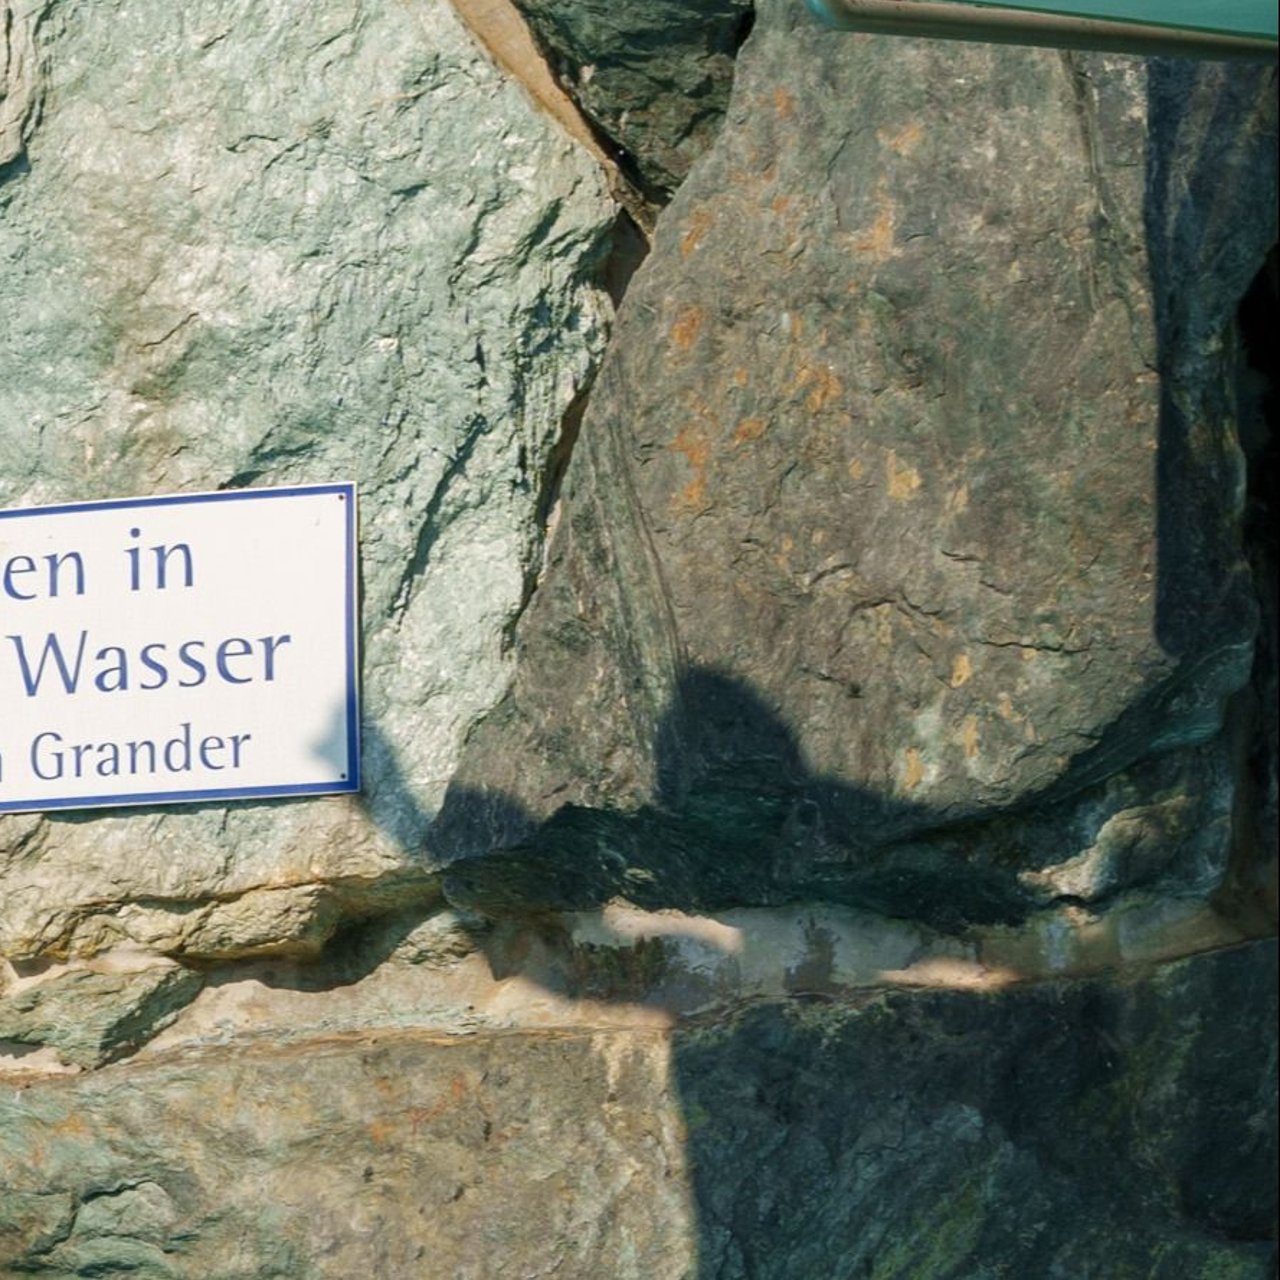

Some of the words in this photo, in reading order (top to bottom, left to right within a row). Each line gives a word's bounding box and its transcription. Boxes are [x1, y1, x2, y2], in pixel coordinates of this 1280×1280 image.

[127, 527, 195, 592] in
[6, 629, 292, 698] Wasser
[30, 724, 252, 781] Grander
